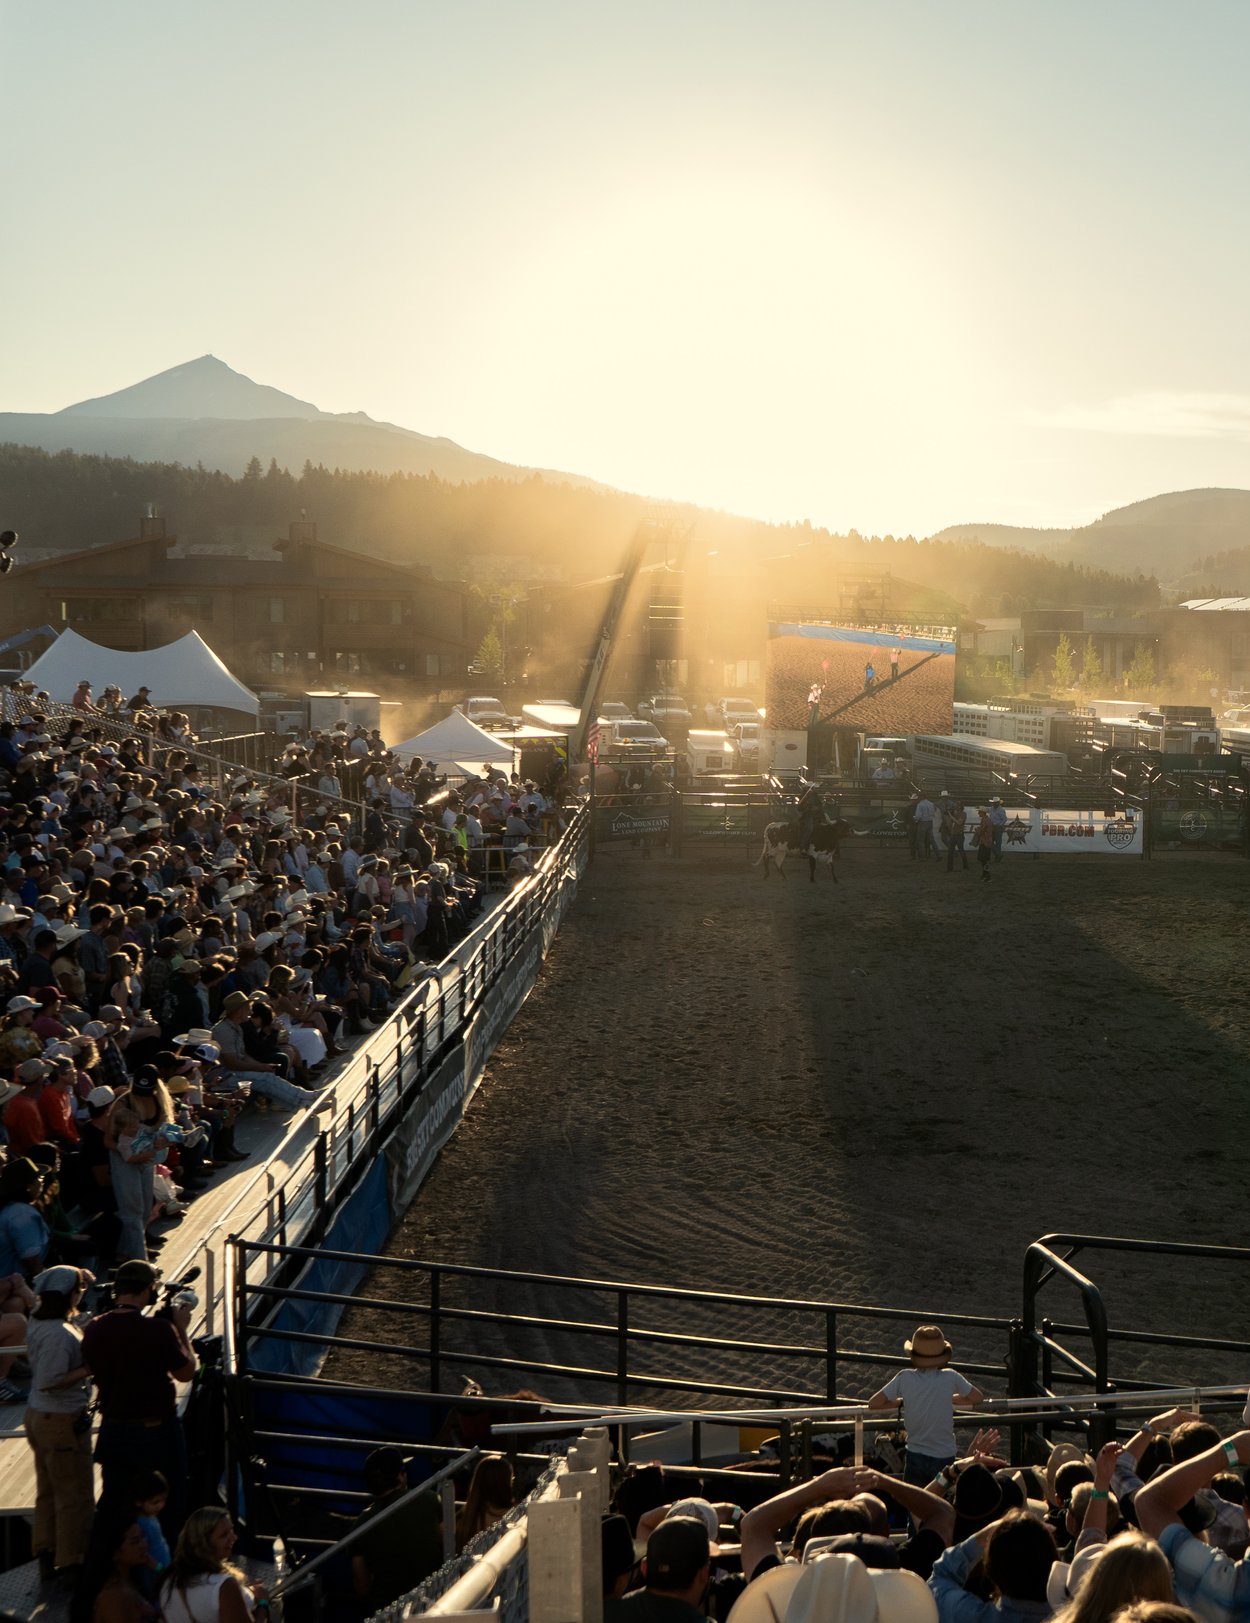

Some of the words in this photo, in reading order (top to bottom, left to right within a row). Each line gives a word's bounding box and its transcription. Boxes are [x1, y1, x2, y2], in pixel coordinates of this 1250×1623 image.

[631, 819, 670, 829] MOUNTAIN
[1041, 824, 1095, 838] PBR.COM
[1110, 833, 1130, 841] PRO
